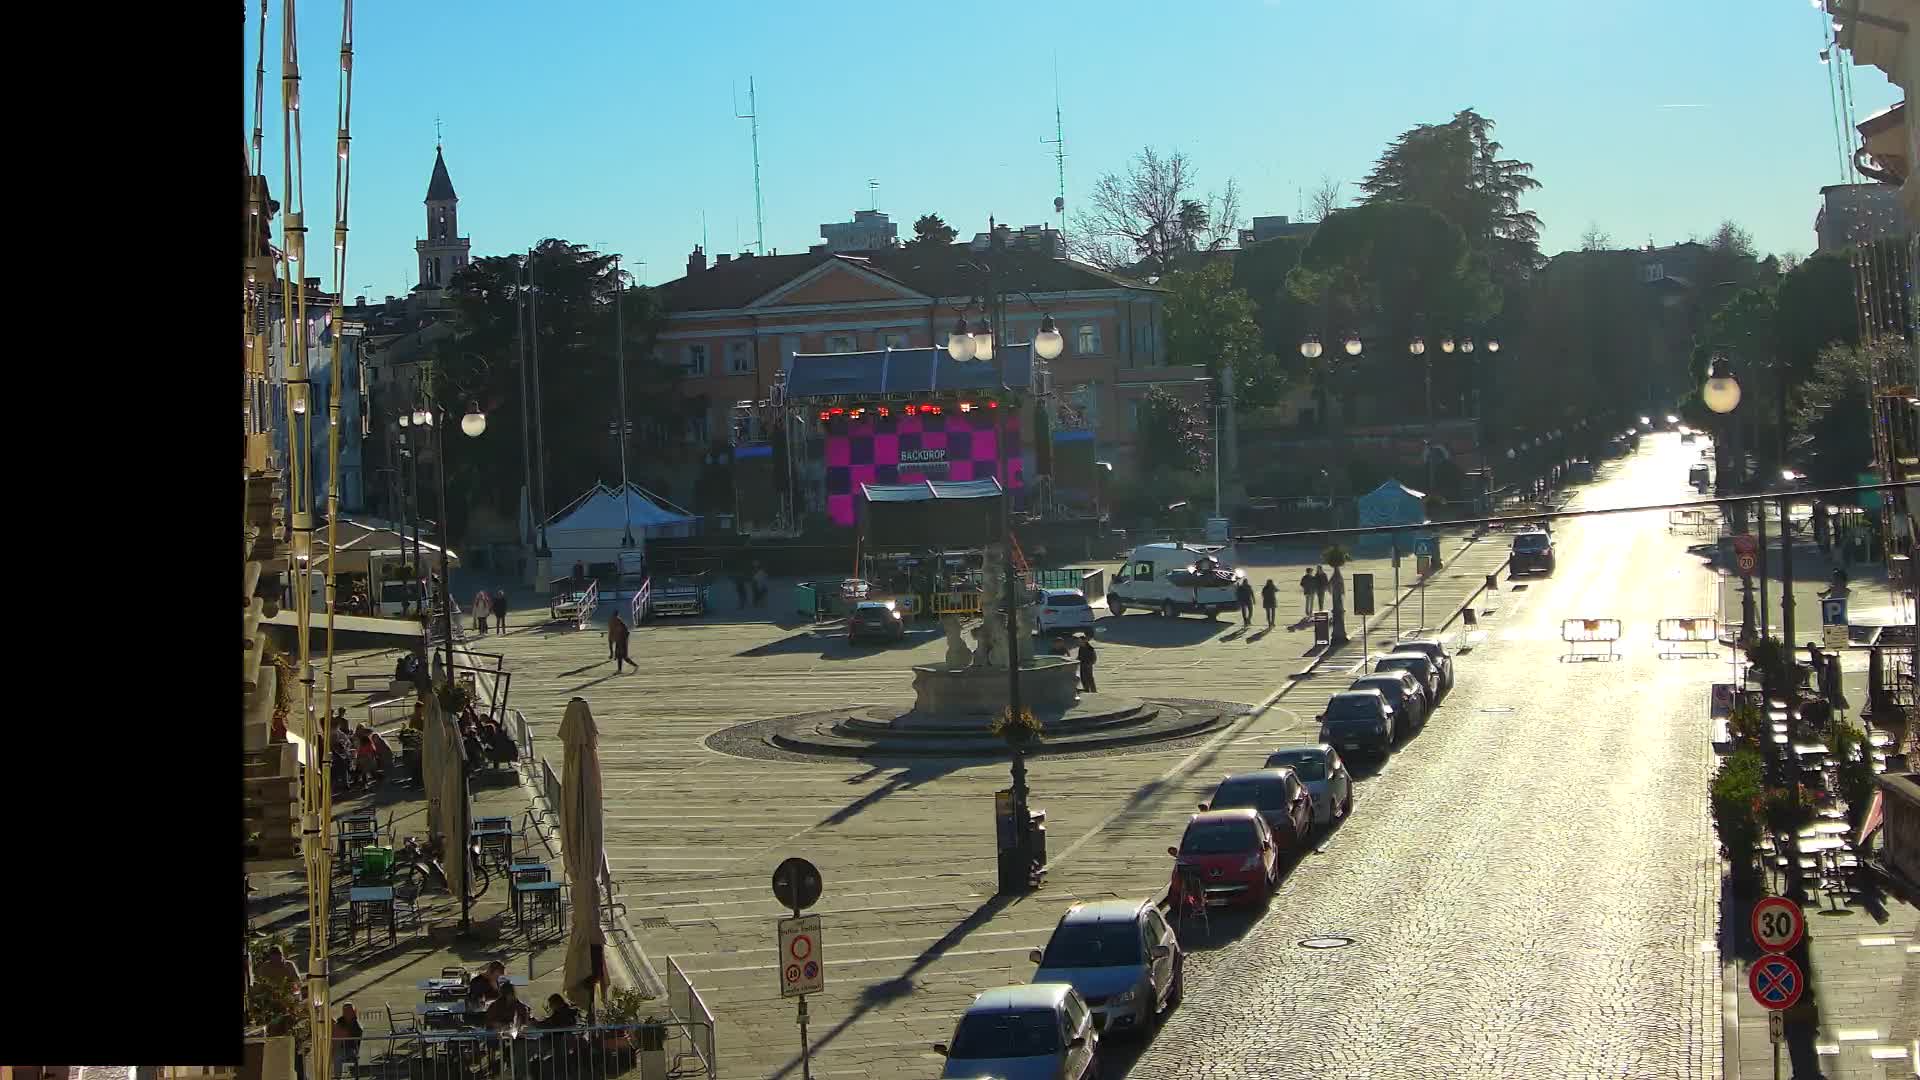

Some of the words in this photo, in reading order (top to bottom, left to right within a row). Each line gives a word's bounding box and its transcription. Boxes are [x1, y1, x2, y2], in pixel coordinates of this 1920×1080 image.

[901, 449, 946, 461] BACKDROP
[1827, 602, 1841, 622] P
[1762, 912, 1791, 938] 30
